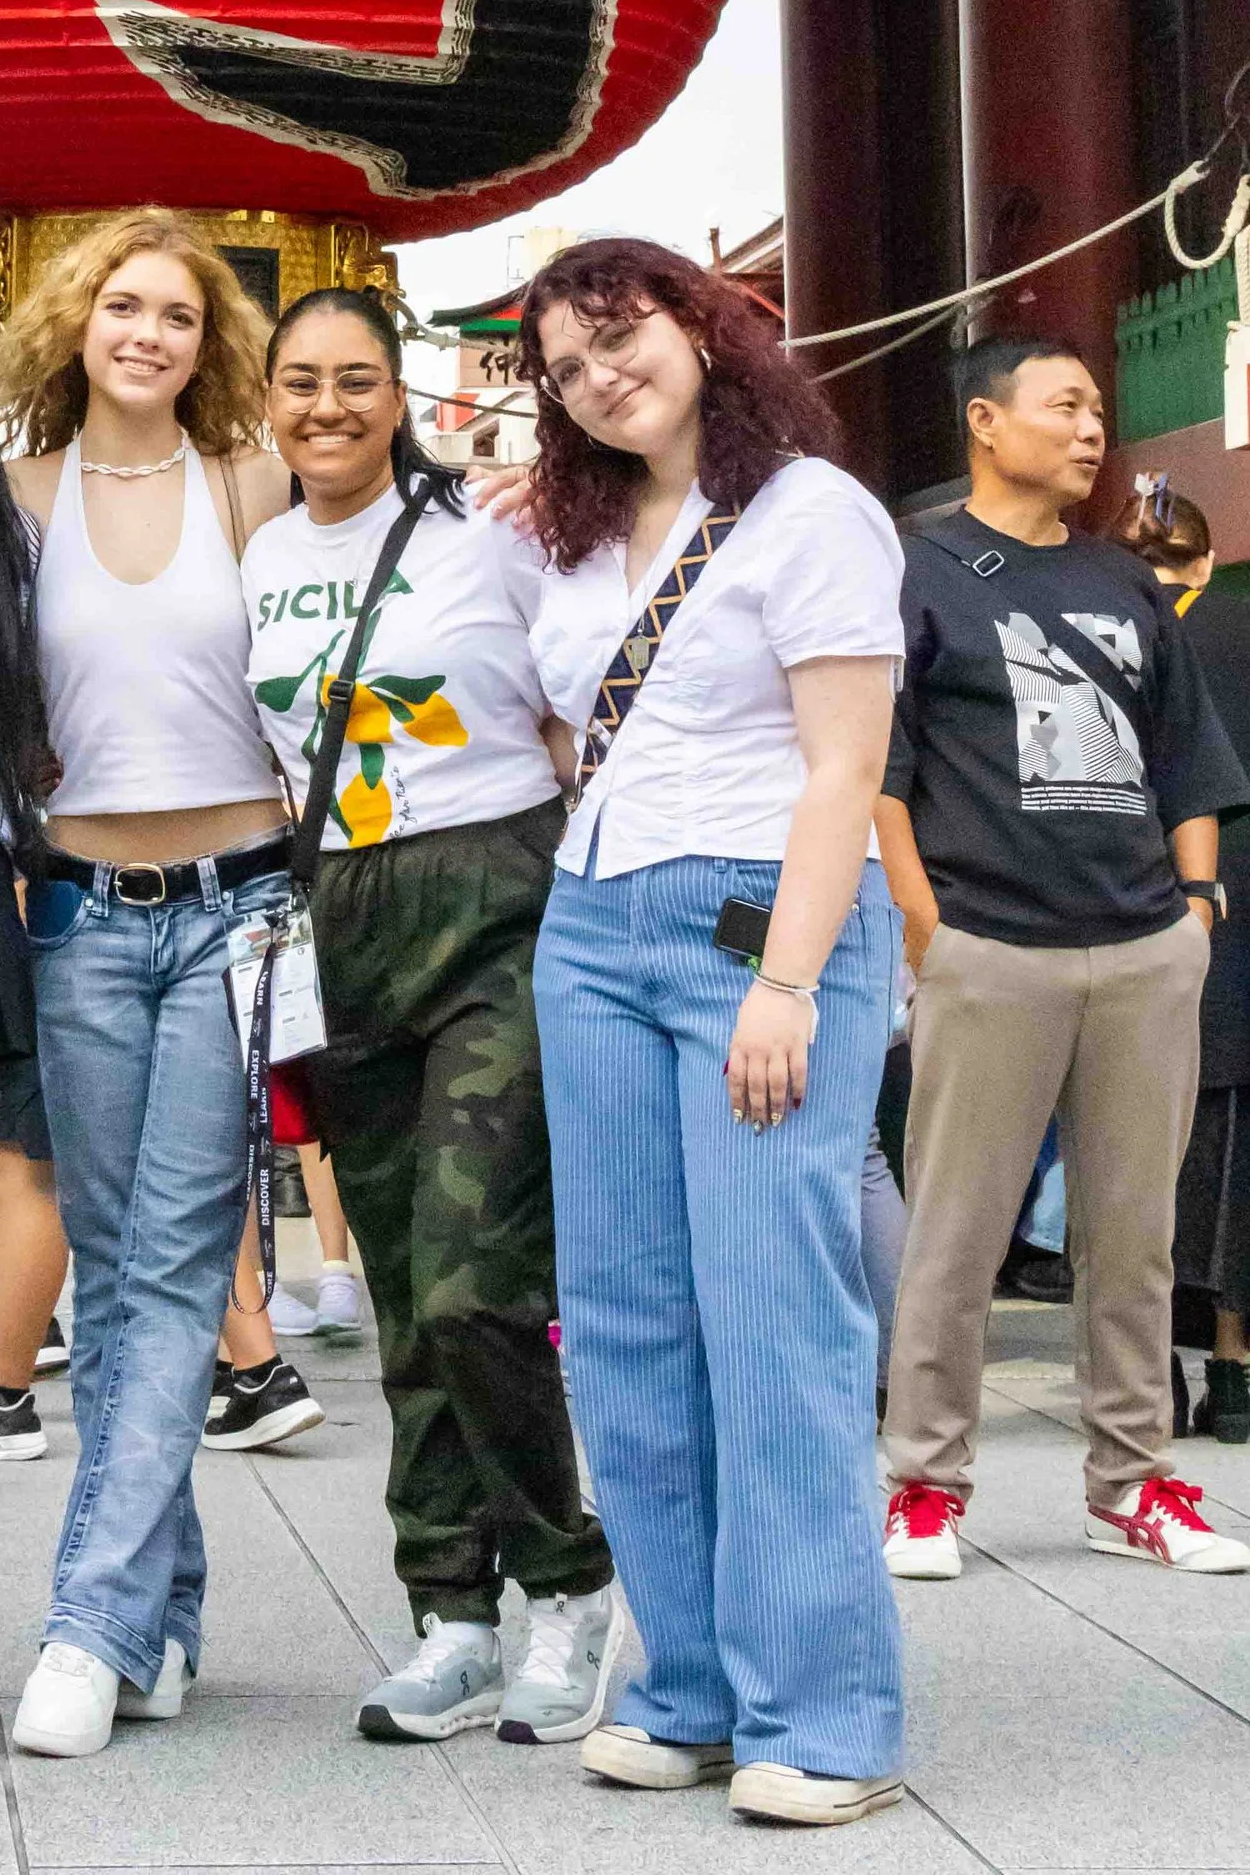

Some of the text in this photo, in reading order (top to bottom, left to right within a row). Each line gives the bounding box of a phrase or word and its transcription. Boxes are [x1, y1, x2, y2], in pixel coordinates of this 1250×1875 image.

[257, 567, 414, 631] SICILA
[250, 1049, 259, 1100] EXPLORE
[260, 1169, 270, 1226] DISCOVER
